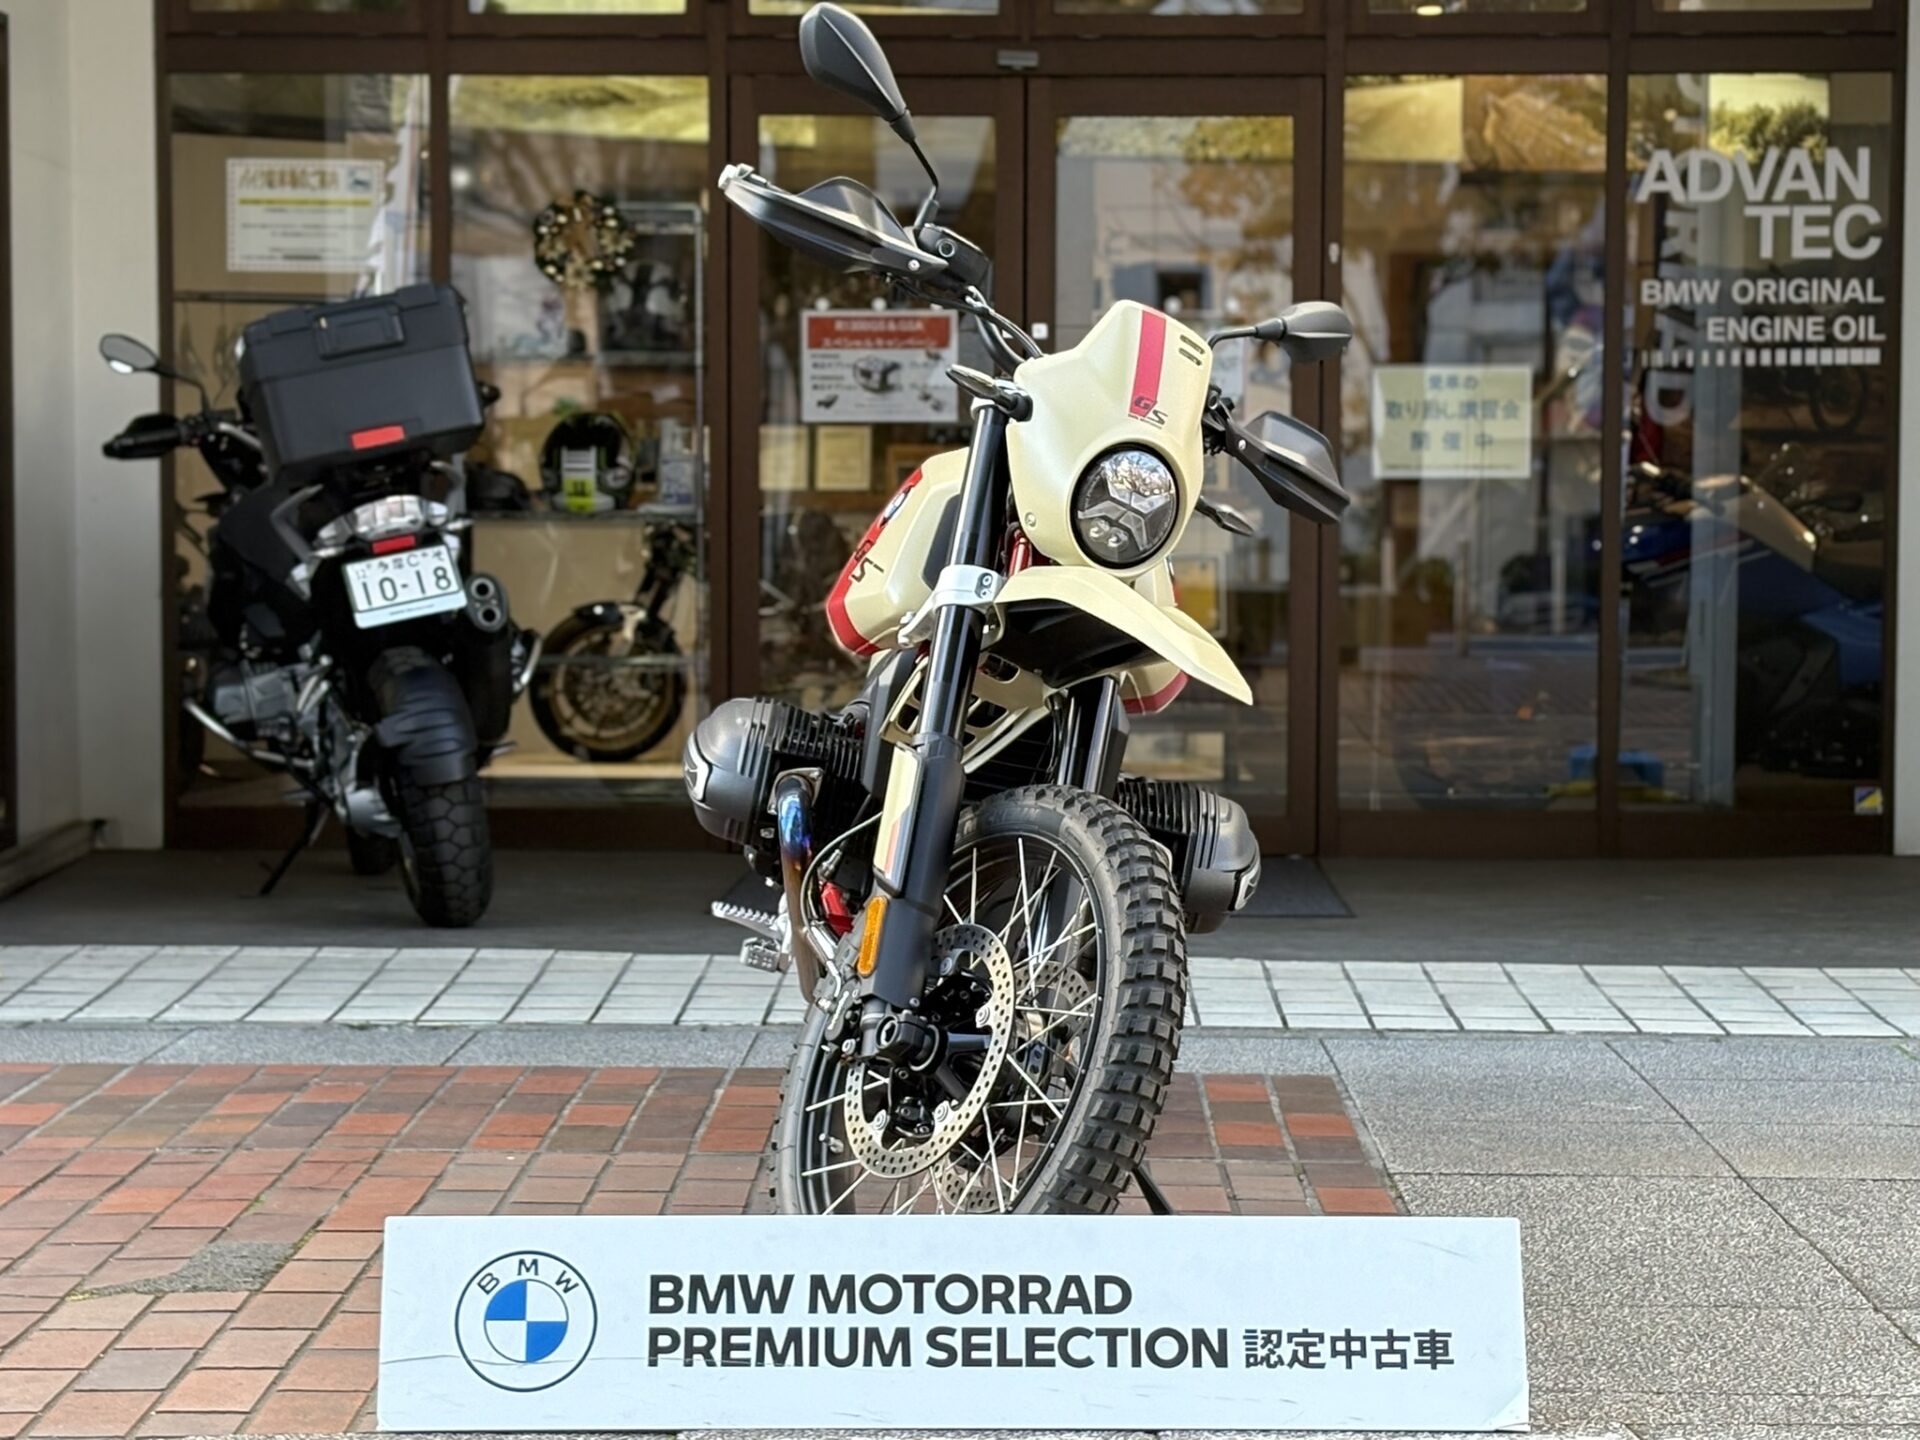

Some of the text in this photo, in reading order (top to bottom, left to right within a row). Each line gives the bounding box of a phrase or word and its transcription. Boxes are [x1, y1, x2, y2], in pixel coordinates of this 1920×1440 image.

[1634, 145, 1871, 203] ADVAN
[1744, 203, 1883, 260] TEC
[1640, 277, 1885, 306] BMW ORIGINAL
[1706, 315, 1886, 343] ENGINE OIL
[1135, 396, 1169, 425] GS
[361, 566, 452, 607] 10-18
[477, 1258, 579, 1297] BMW
[650, 1274, 1132, 1315] BMW MOTORRAD
[649, 1326, 1455, 1370] PREMIUM SELECTION 認定中古車
